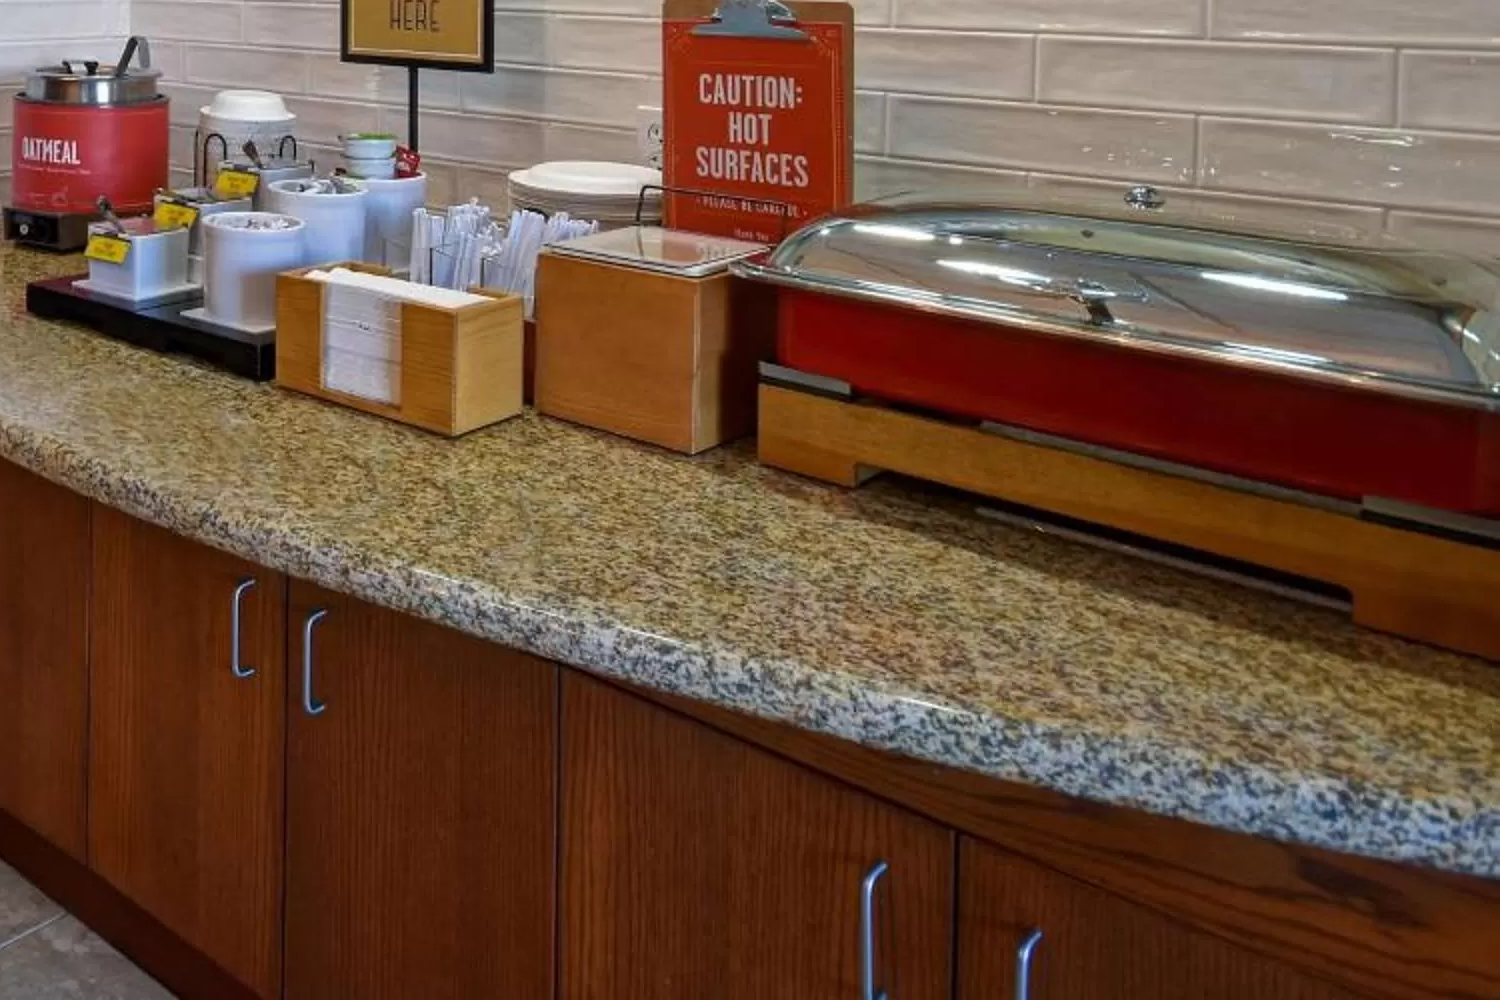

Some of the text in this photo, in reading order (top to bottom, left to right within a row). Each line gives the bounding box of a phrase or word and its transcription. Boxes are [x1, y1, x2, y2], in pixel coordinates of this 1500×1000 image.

[389, 0, 441, 32] HERE
[699, 73, 803, 109] CAUTION:
[728, 111, 773, 146] HOT
[22, 135, 81, 165] OATMEAL
[696, 146, 809, 188] SURFACES
